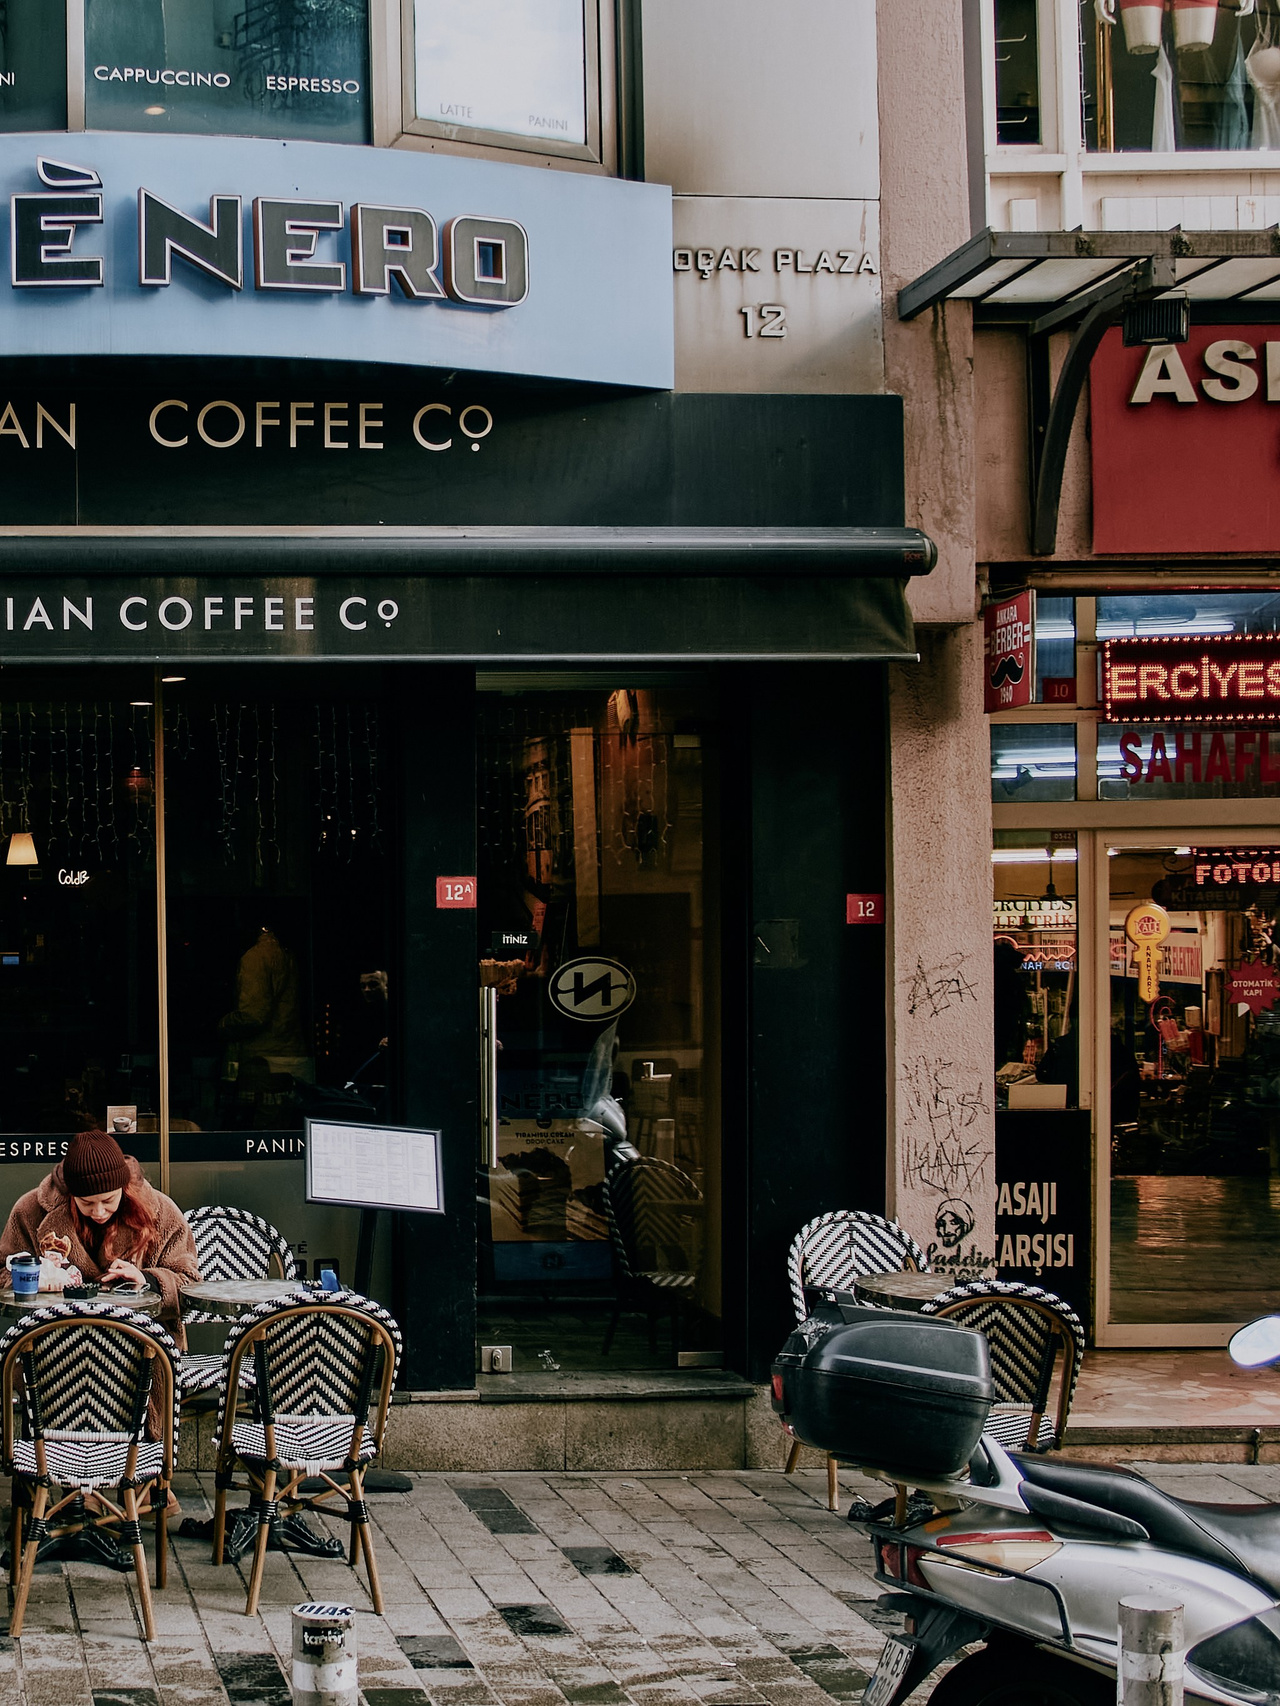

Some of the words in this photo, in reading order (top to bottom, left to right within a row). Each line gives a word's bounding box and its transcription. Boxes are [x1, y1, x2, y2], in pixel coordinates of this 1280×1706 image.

[93, 65, 231, 89] CAPPUCCINO
[266, 75, 360, 95] ESPRESSO
[439, 102, 473, 119] LATTE
[528, 114, 569, 131] PANINI
[136, 187, 530, 308] NERO
[776, 250, 878, 274] PLAZA
[741, 306, 788, 339] 12
[149, 400, 384, 449] COFFEE
[119, 597, 315, 632] COFFEE
[995, 604, 1018, 628] ANKARA
[990, 621, 1024, 657] BERBER
[1053, 684, 1069, 698] 10
[857, 901, 875, 918] 12
[1134, 920, 1162, 936] KALE
[502, 934, 528, 944] İTİNİZ
[1232, 979, 1274, 989] OTOMATİK
[1243, 989, 1263, 997] KAPI
